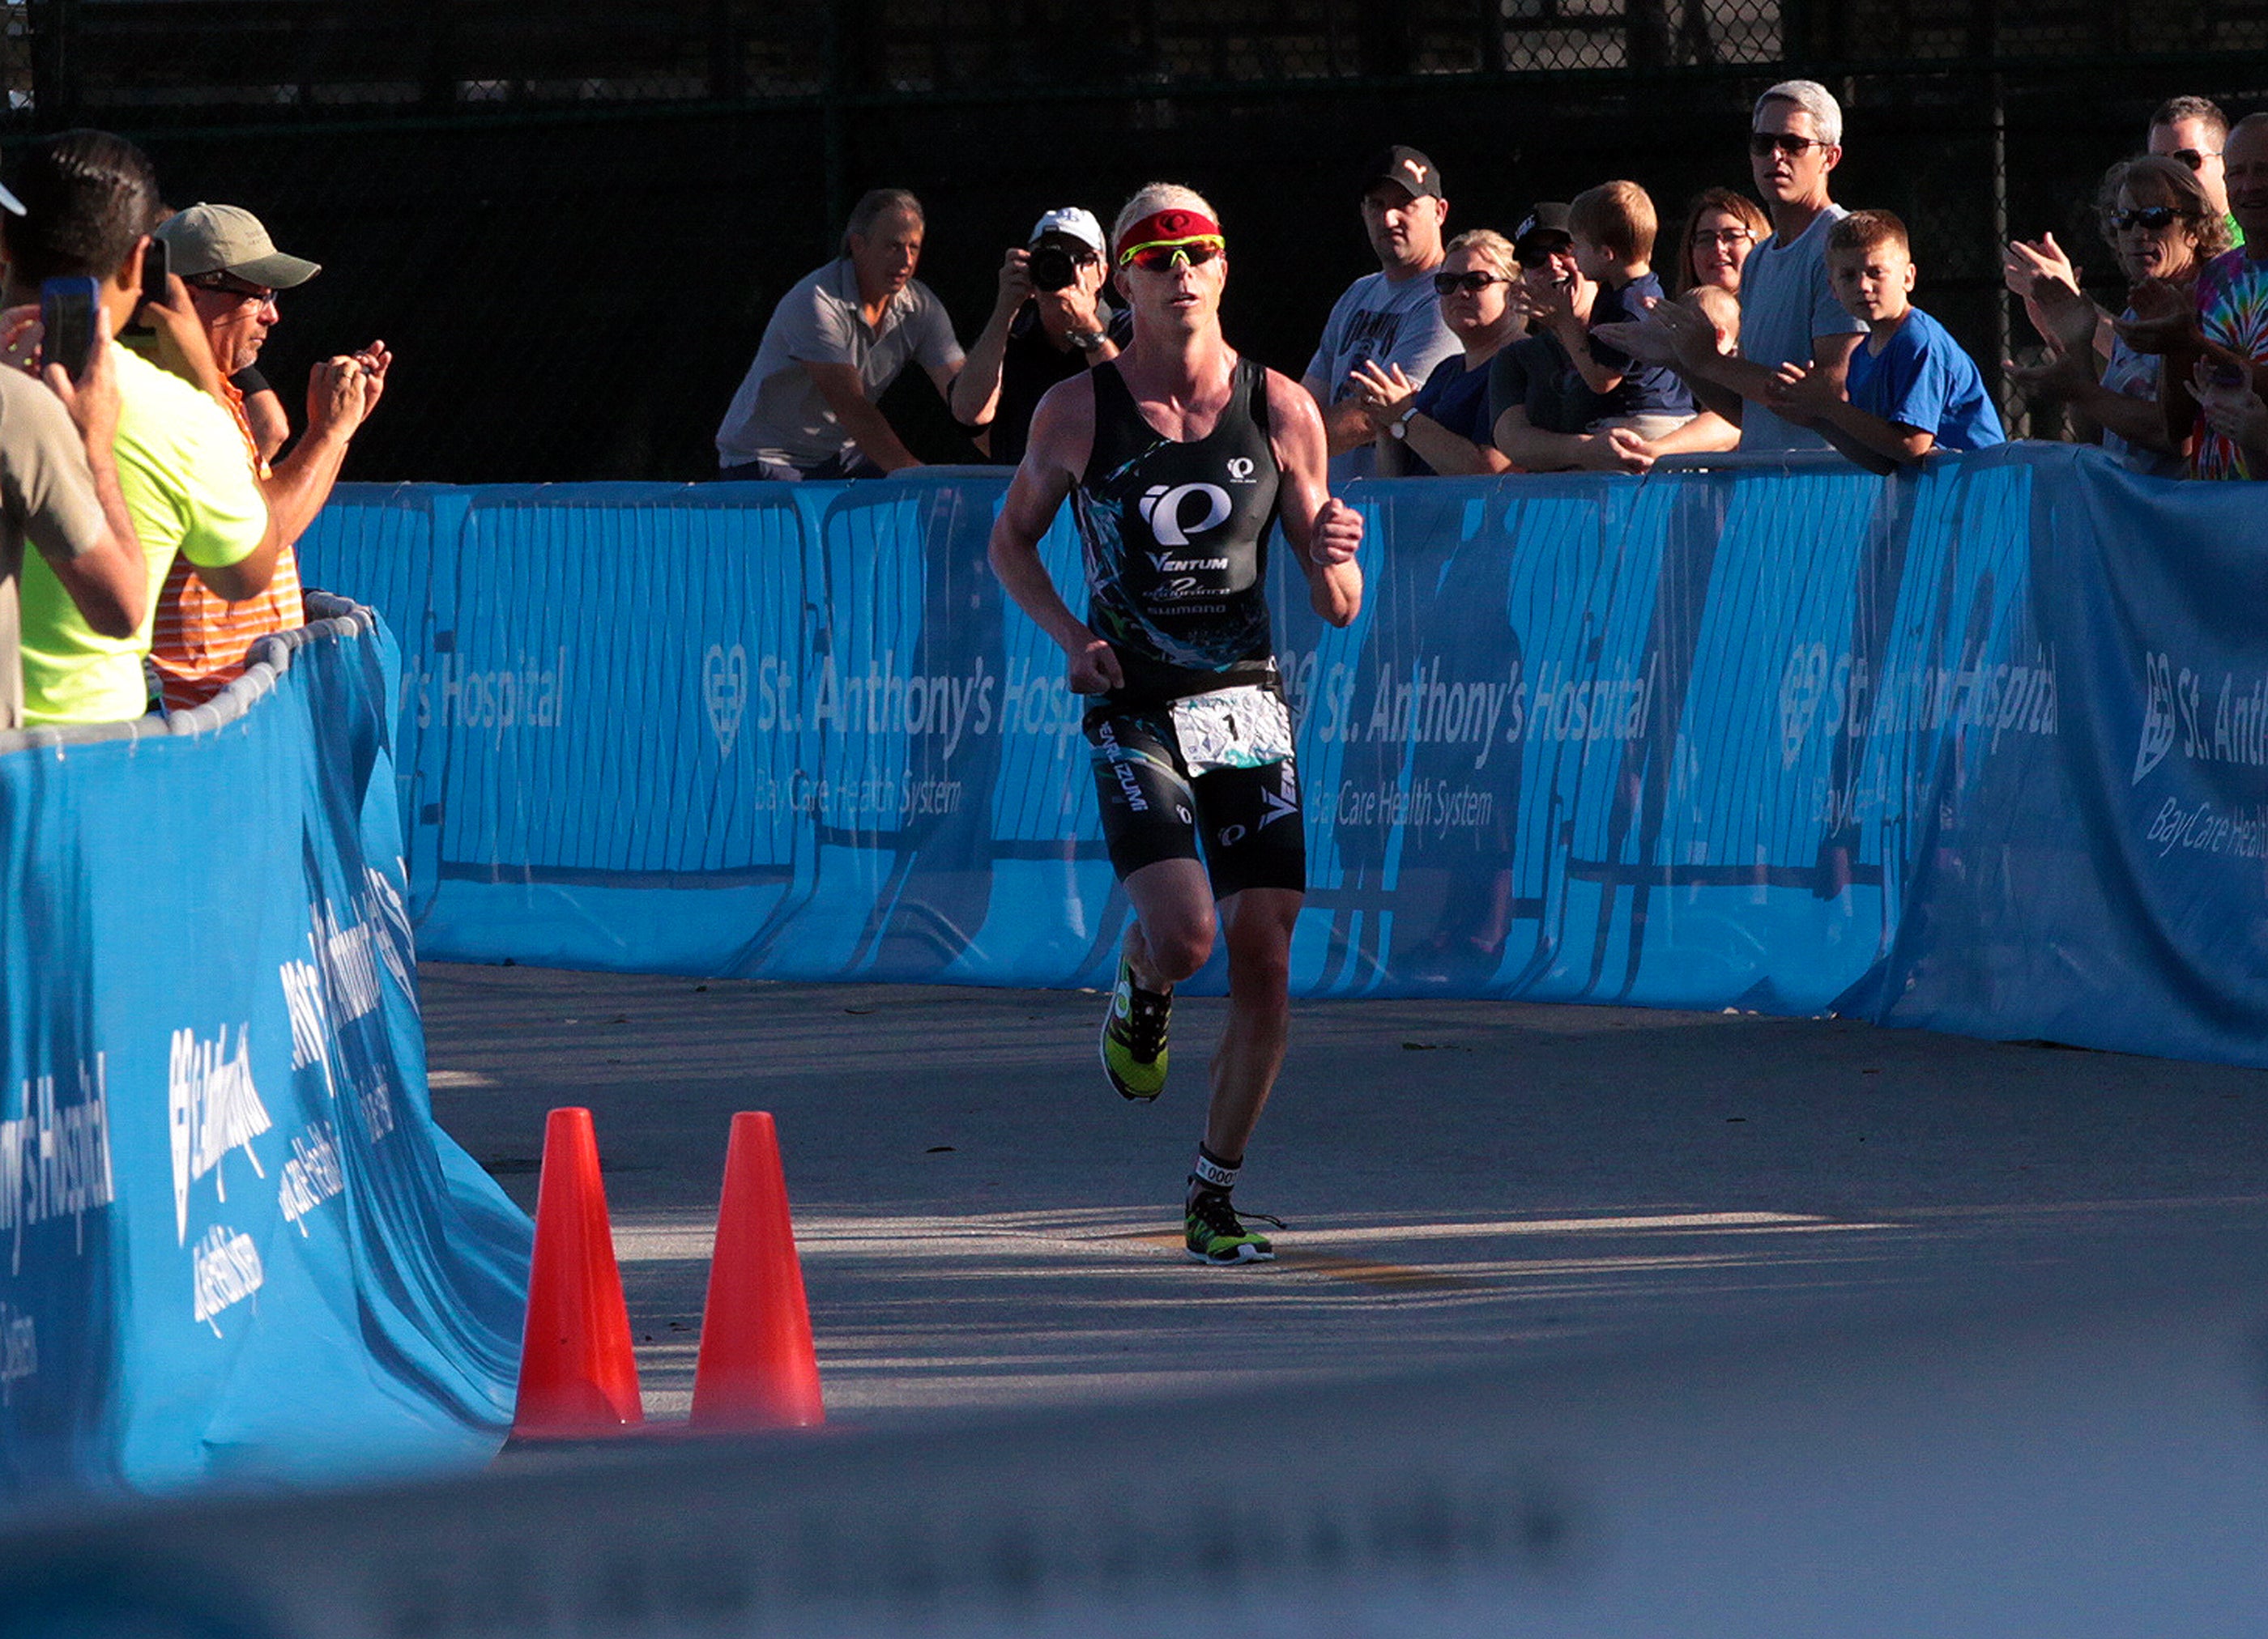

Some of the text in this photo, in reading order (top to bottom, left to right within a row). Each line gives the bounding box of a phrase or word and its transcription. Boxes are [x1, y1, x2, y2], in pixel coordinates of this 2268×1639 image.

[441, 645, 565, 751] Hospital
[758, 654, 803, 730] St.
[812, 650, 994, 760] Anthony's
[1222, 713, 1238, 741] 1
[1319, 650, 1658, 769] St. Anthony's Hospital
[2178, 667, 2210, 759] St.
[899, 769, 961, 826] System
[1379, 777, 1432, 825] Health
[1434, 779, 1494, 840] System
